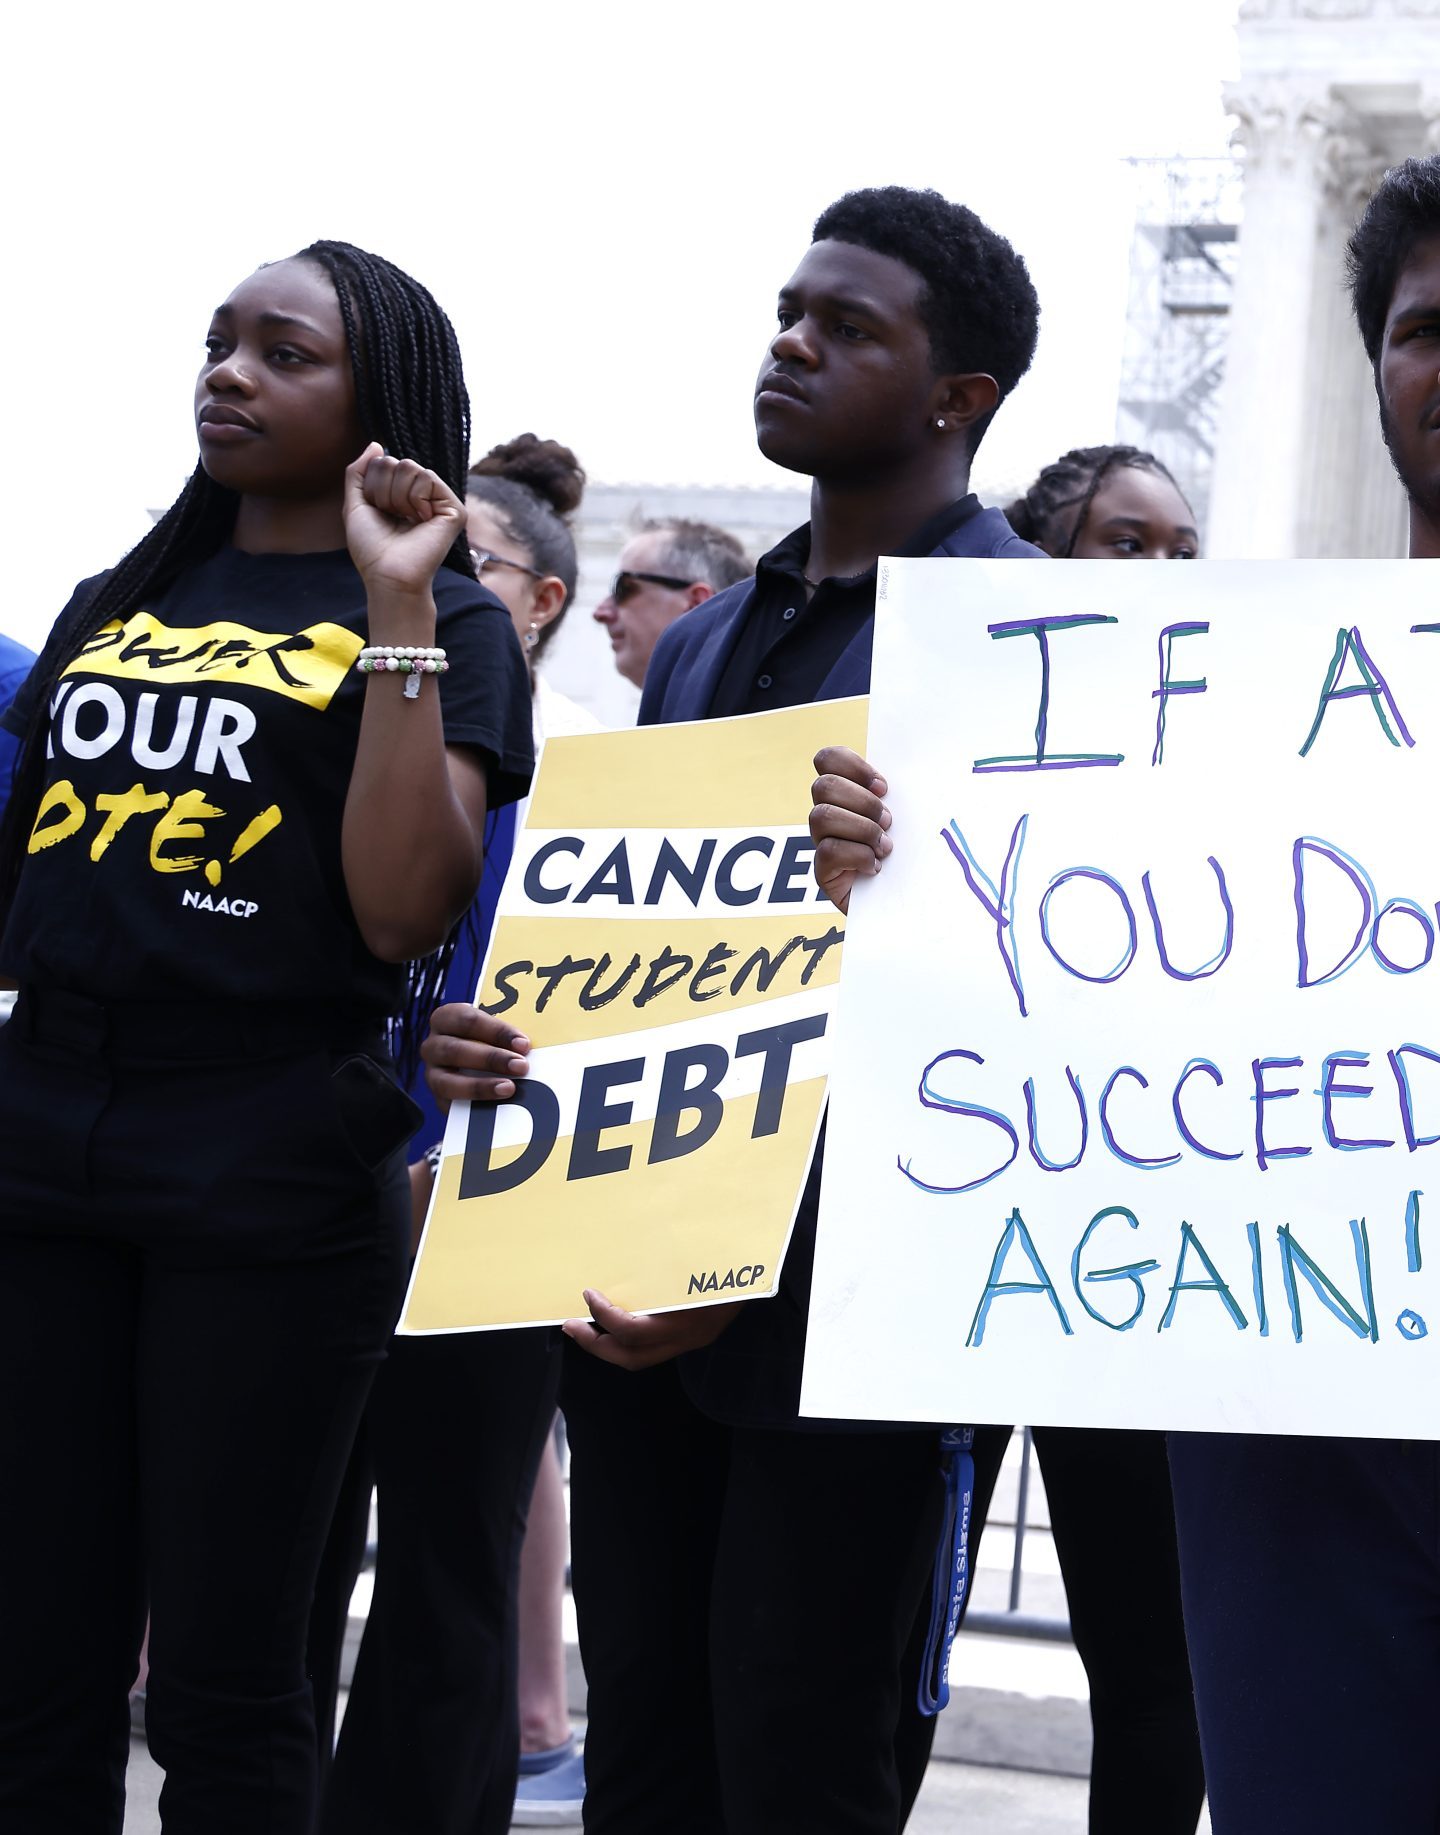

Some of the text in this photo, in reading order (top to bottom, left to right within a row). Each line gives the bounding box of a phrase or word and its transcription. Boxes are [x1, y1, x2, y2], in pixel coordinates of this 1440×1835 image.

[972, 614, 1210, 773] IF
[28, 779, 283, 887] OTE!
[522, 834, 832, 906] CANCE
[181, 889, 259, 919] NAACP
[940, 813, 1234, 1017] YOU
[478, 926, 846, 1018] STUDENT
[458, 1013, 829, 1200] DEBT
[688, 1264, 765, 1296] NAACP
[966, 1189, 1428, 1348] AGAIN!
[956, 1491, 971, 1573] Sigma
